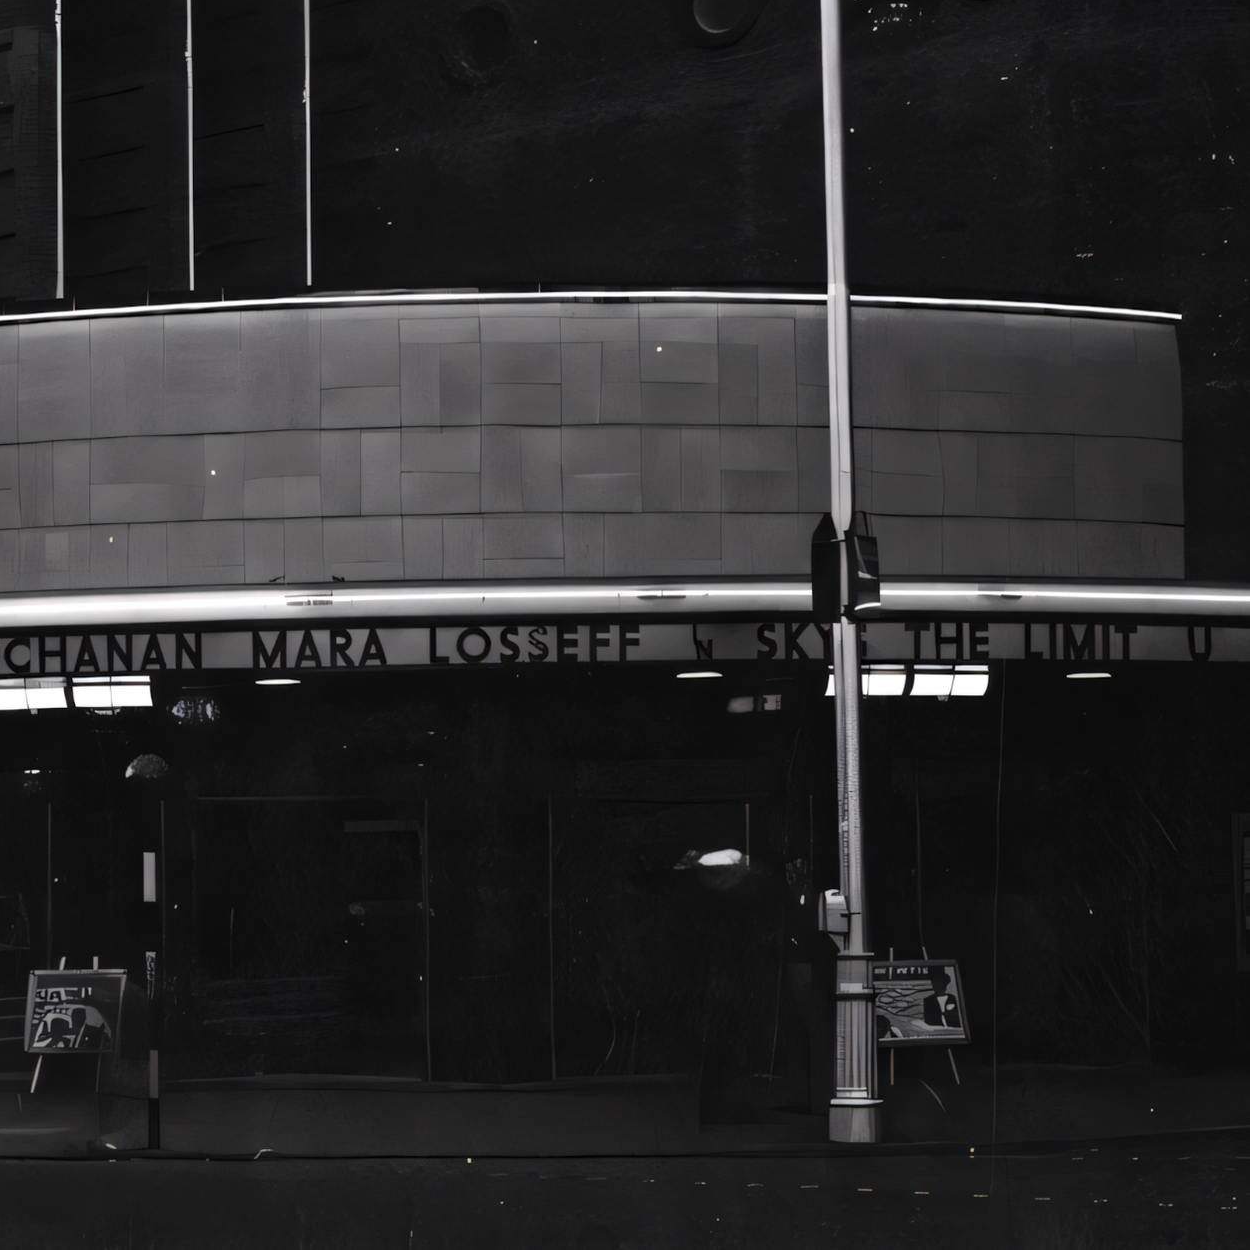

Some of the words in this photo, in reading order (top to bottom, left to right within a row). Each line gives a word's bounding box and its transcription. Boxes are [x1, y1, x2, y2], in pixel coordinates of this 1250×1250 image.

[252, 628, 387, 668] MARA
[429, 624, 640, 663] LOSSEFF
[904, 622, 989, 660] THE
[1024, 623, 1138, 660] LIMIT
